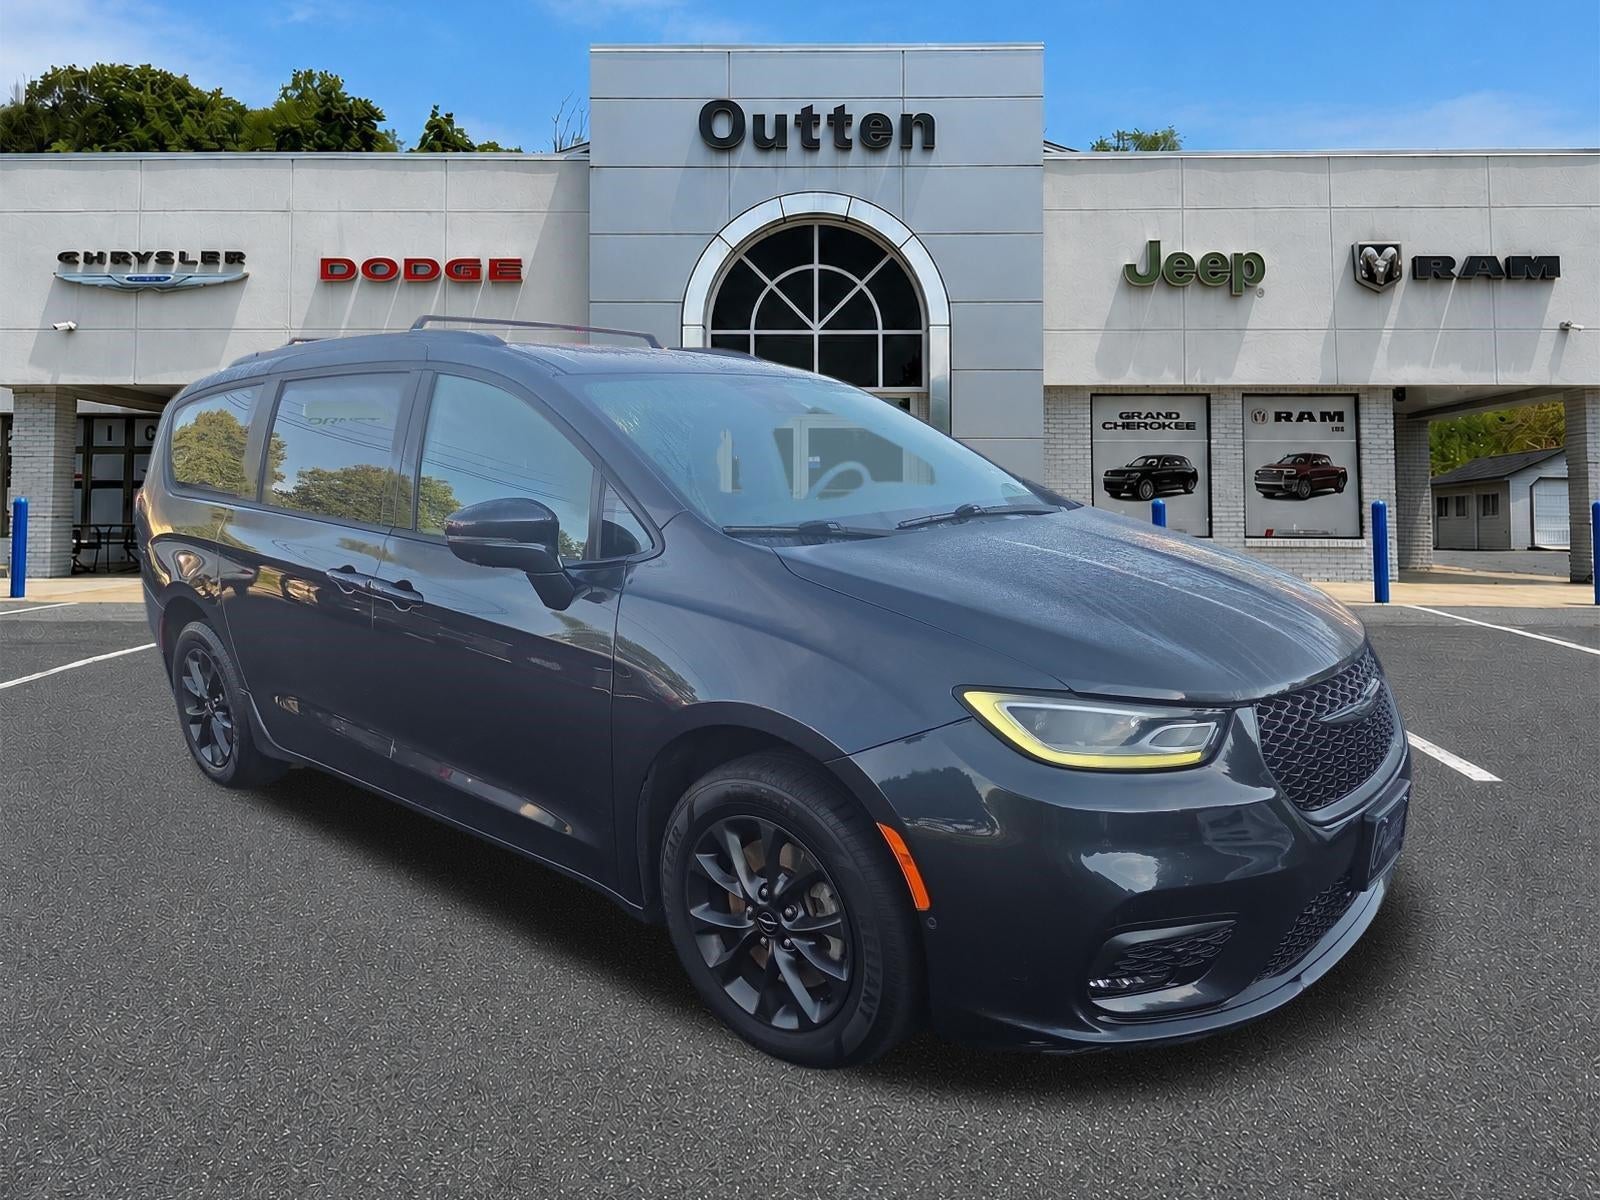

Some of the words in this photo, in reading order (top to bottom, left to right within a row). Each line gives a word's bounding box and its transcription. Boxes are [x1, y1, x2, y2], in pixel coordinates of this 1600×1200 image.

[699, 99, 936, 151] Outten
[57, 250, 247, 266] CHRYSLER
[1122, 239, 1266, 297] Jeep
[1411, 255, 1561, 281] RAM
[320, 256, 523, 283] DODGE
[1101, 421, 1197, 431] CHEROKEE
[1118, 411, 1181, 421] GRAND
[1274, 410, 1345, 423] RAM
